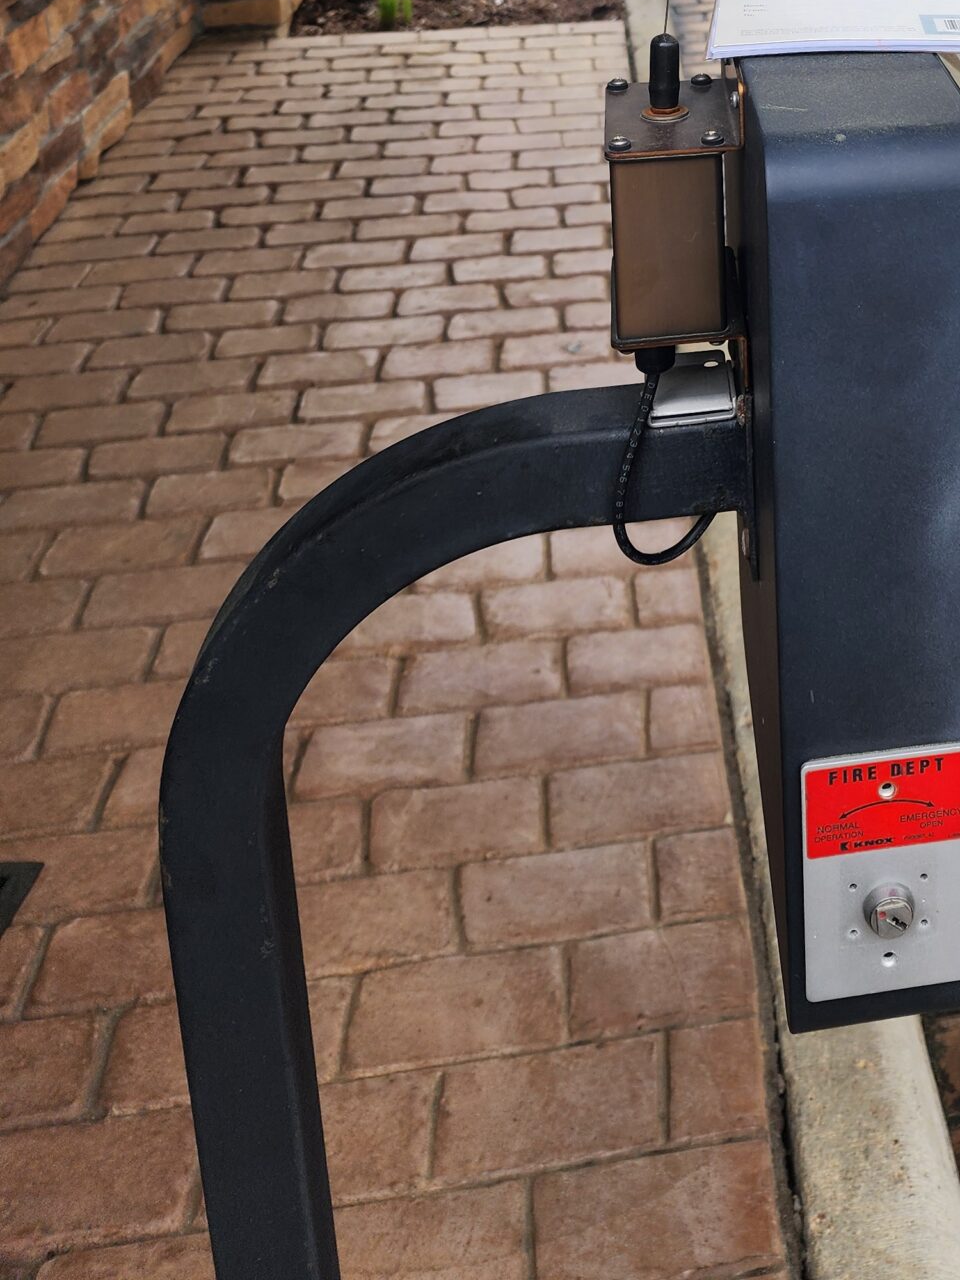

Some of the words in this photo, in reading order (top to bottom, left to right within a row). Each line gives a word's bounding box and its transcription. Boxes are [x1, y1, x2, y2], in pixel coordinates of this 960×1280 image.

[828, 766, 877, 785] FIRE
[890, 757, 944, 777] DEPT
[817, 822, 860, 834] NORMAL
[920, 820, 944, 829] OPEN
[814, 831, 864, 843] OPERATION
[854, 837, 894, 848] KNOX
